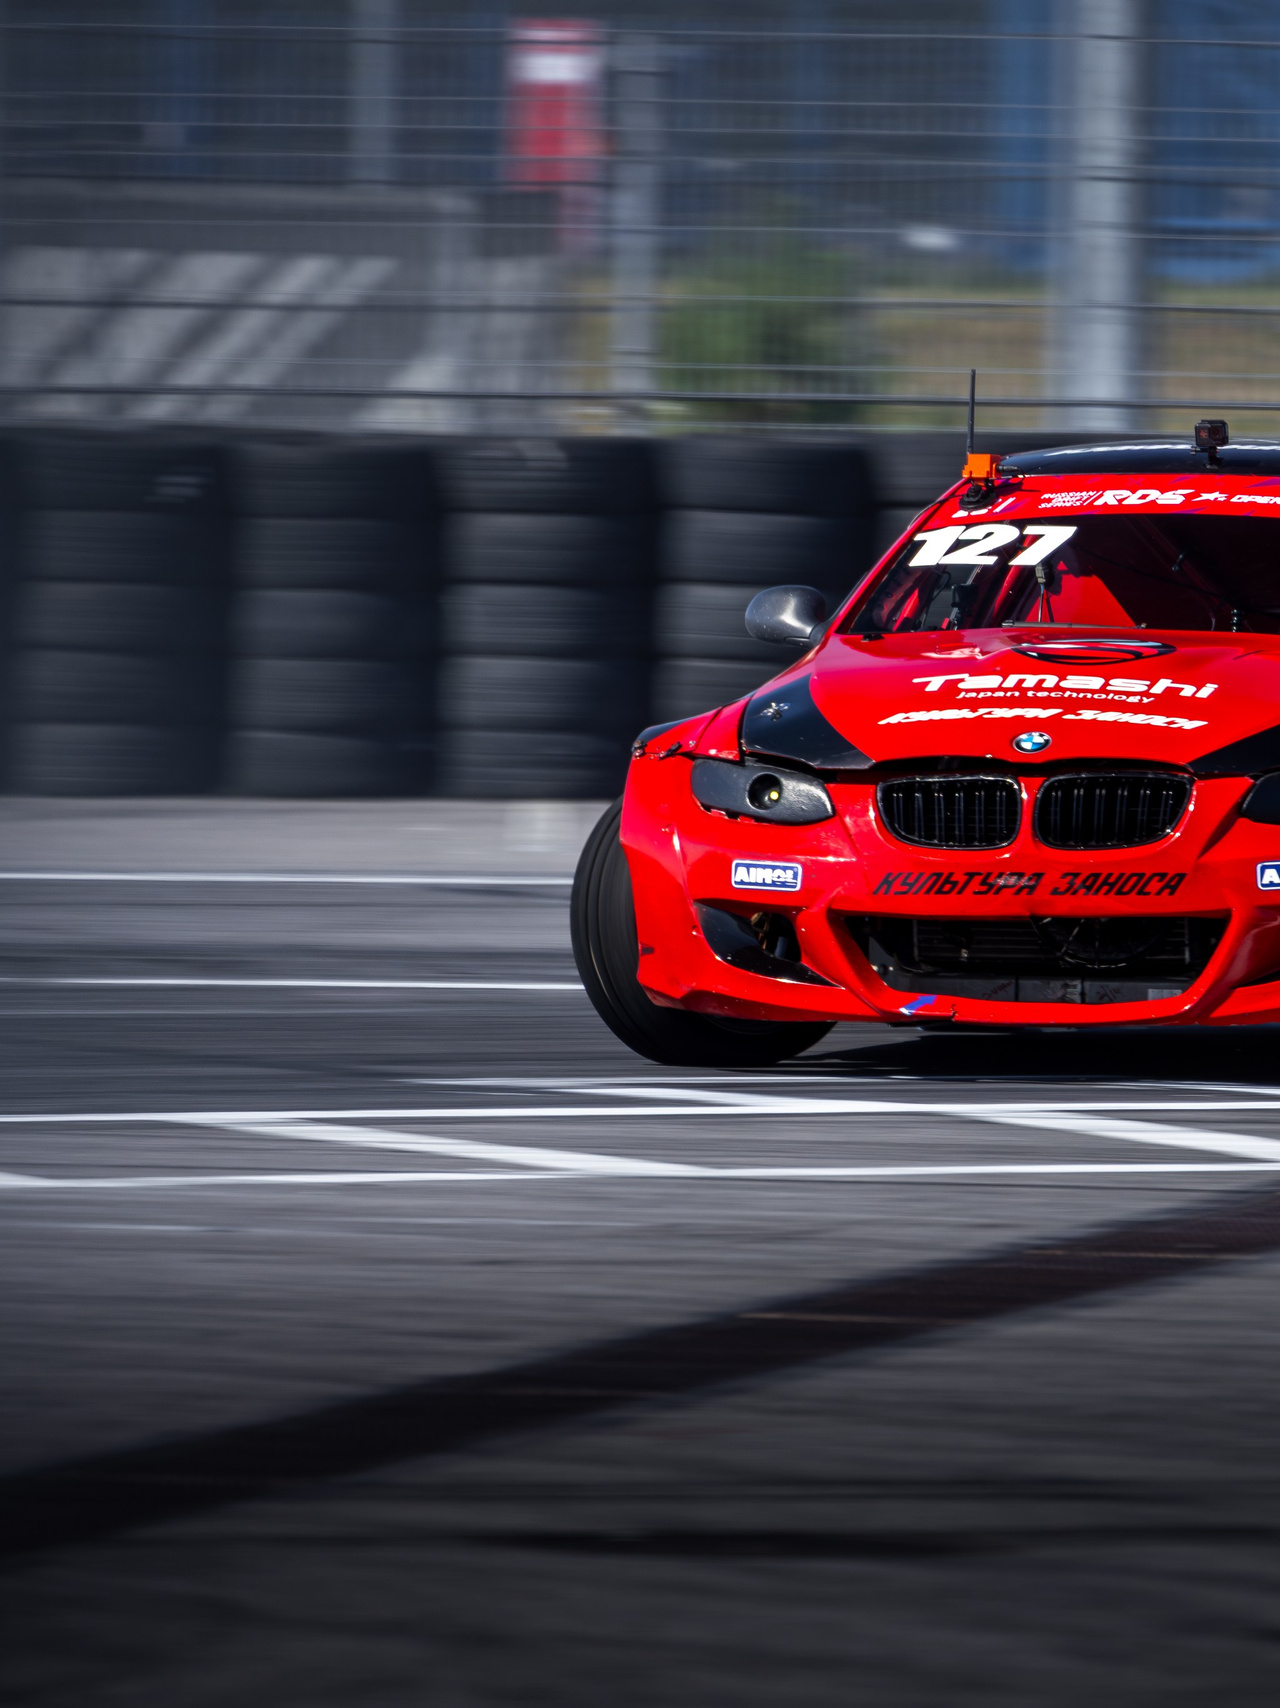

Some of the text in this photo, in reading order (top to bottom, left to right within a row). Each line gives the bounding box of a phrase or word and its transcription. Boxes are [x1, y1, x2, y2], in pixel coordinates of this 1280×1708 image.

[1093, 489, 1195, 505] RDS
[908, 523, 1078, 567] 127
[912, 673, 1219, 699] Tamashi
[1027, 689, 1155, 704] technology
[734, 866, 798, 886] AIMOL
[872, 871, 1188, 896] КУЛЬТУРА ЗАНОСА
